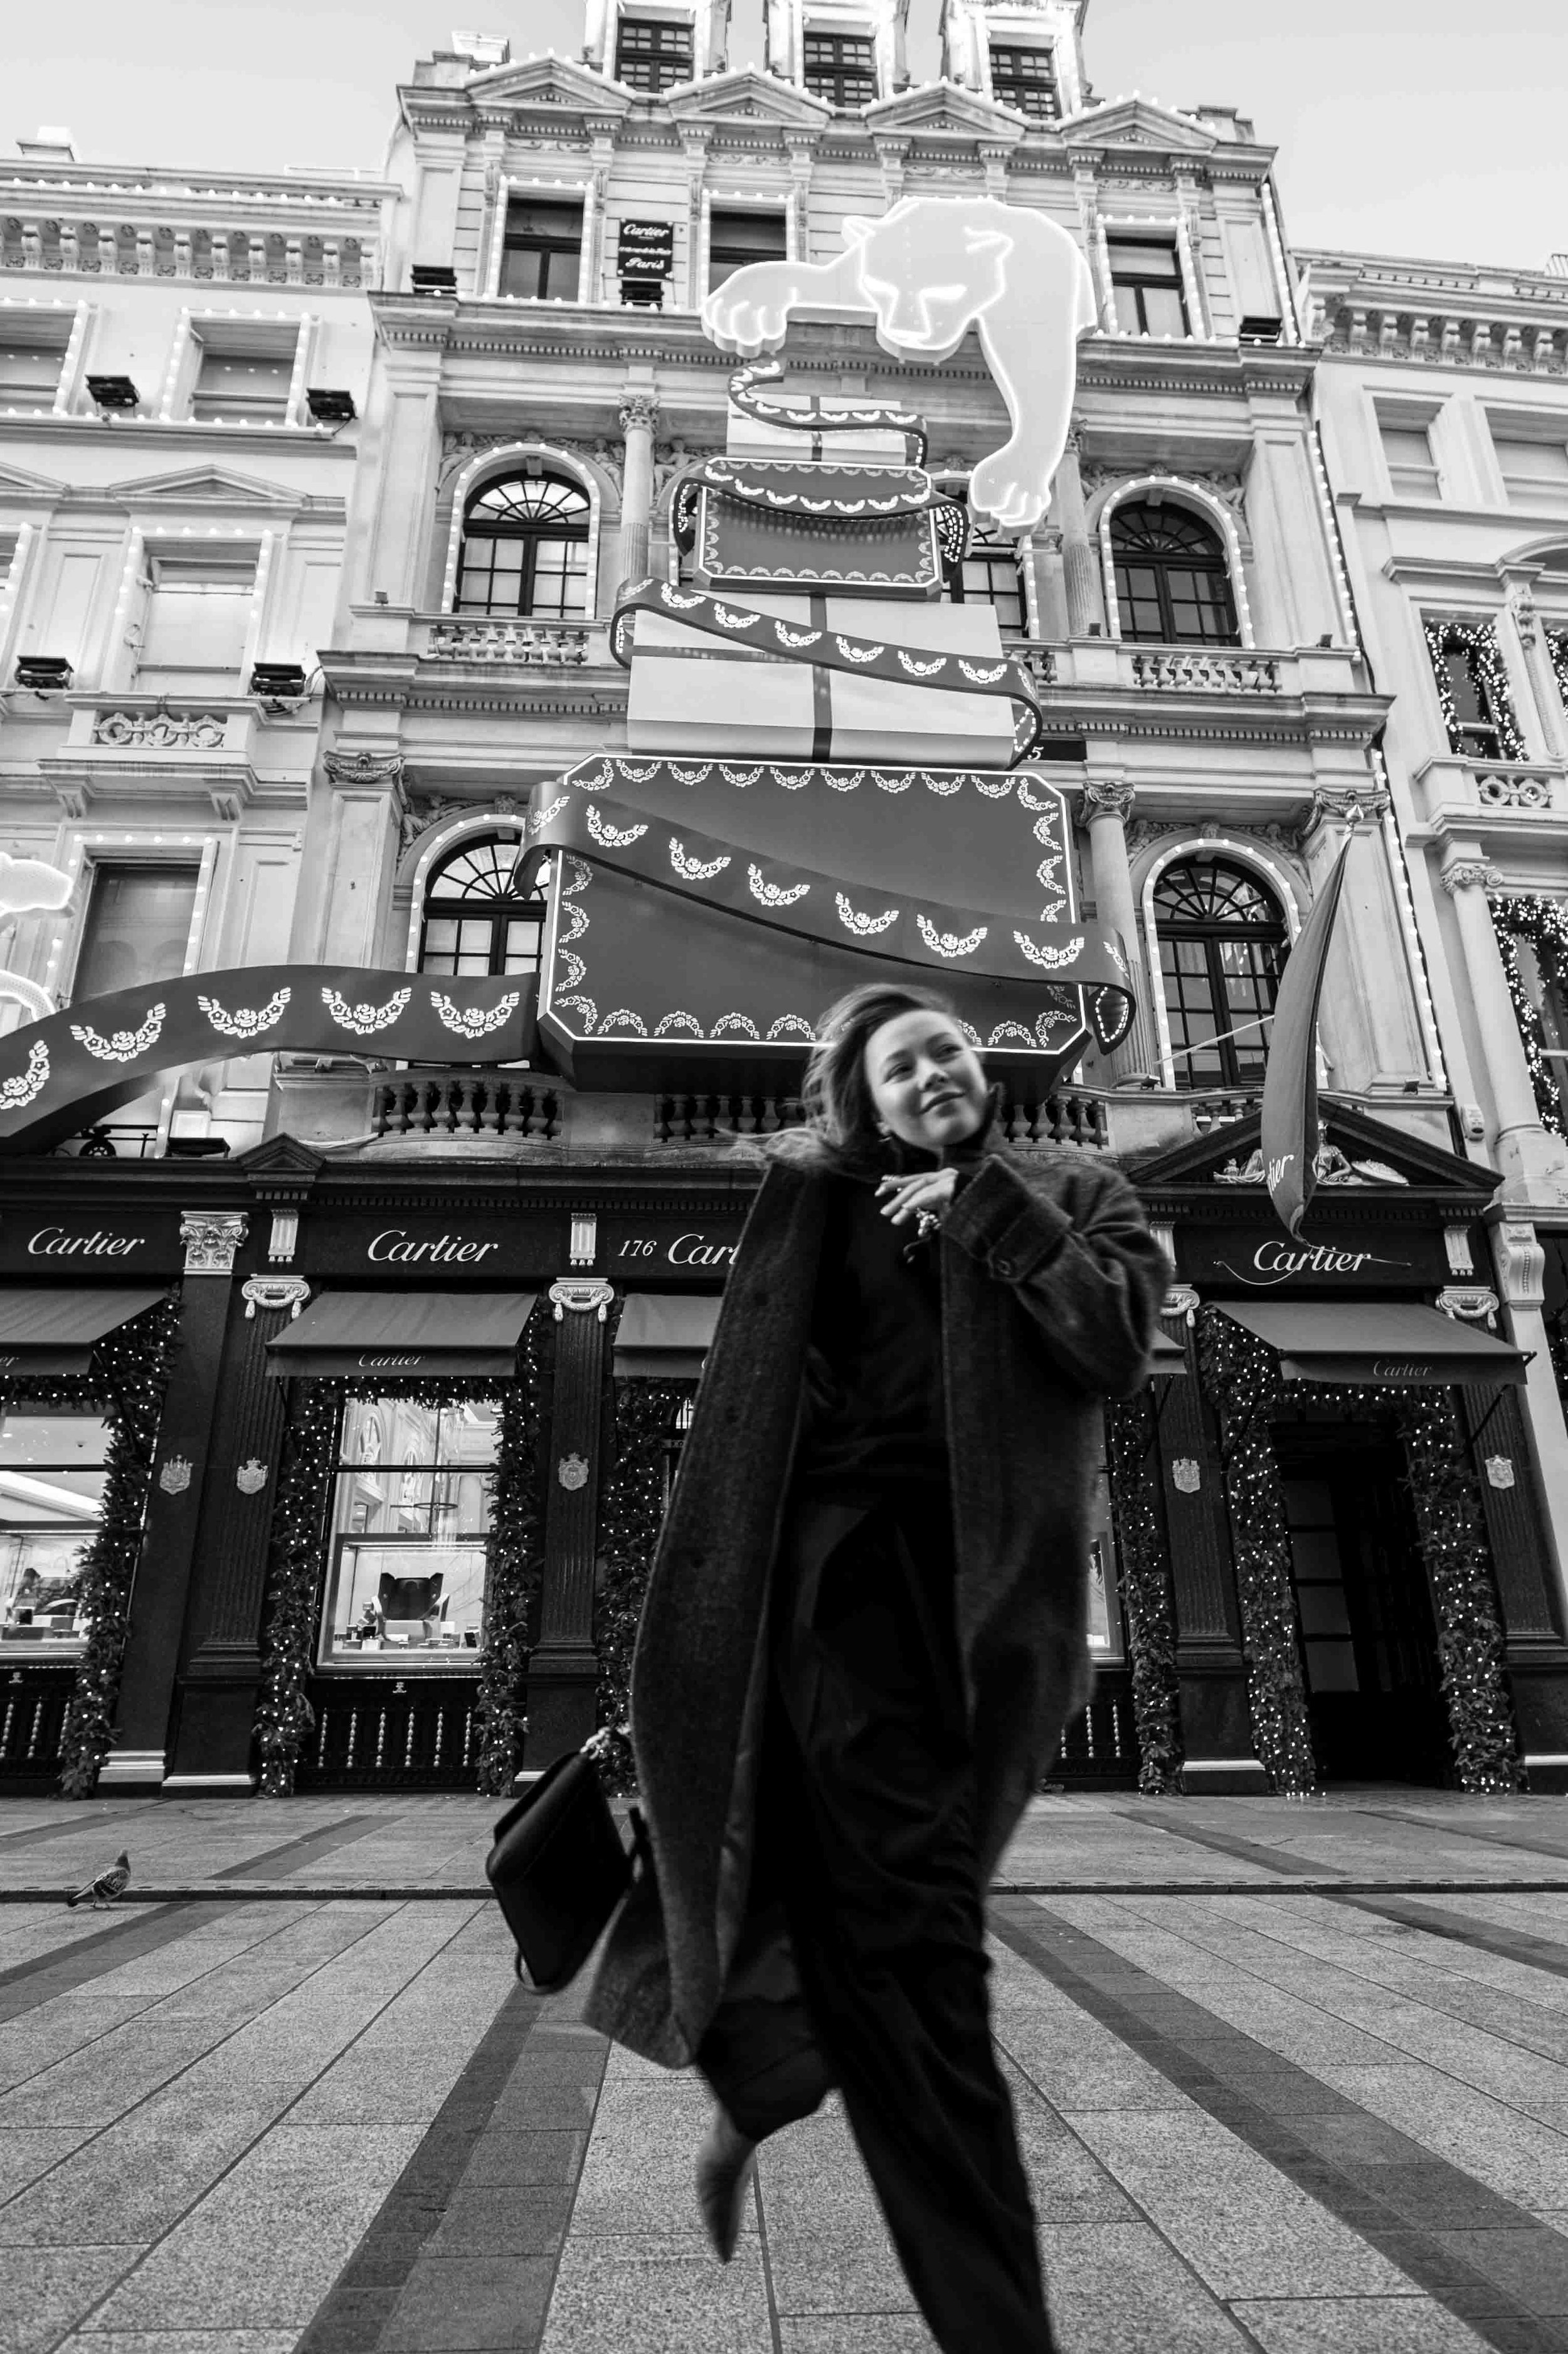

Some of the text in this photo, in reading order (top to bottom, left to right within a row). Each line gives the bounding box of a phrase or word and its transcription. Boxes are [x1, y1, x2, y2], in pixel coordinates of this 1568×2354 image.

[623, 224, 670, 238] Cartier
[625, 257, 665, 270] Paris
[28, 1226, 146, 1255] Cartier
[368, 1229, 499, 1262] Cartier
[618, 1239, 657, 1256] 176
[1253, 1241, 1372, 1271] Cartier
[1373, 1360, 1433, 1377] Cartier
